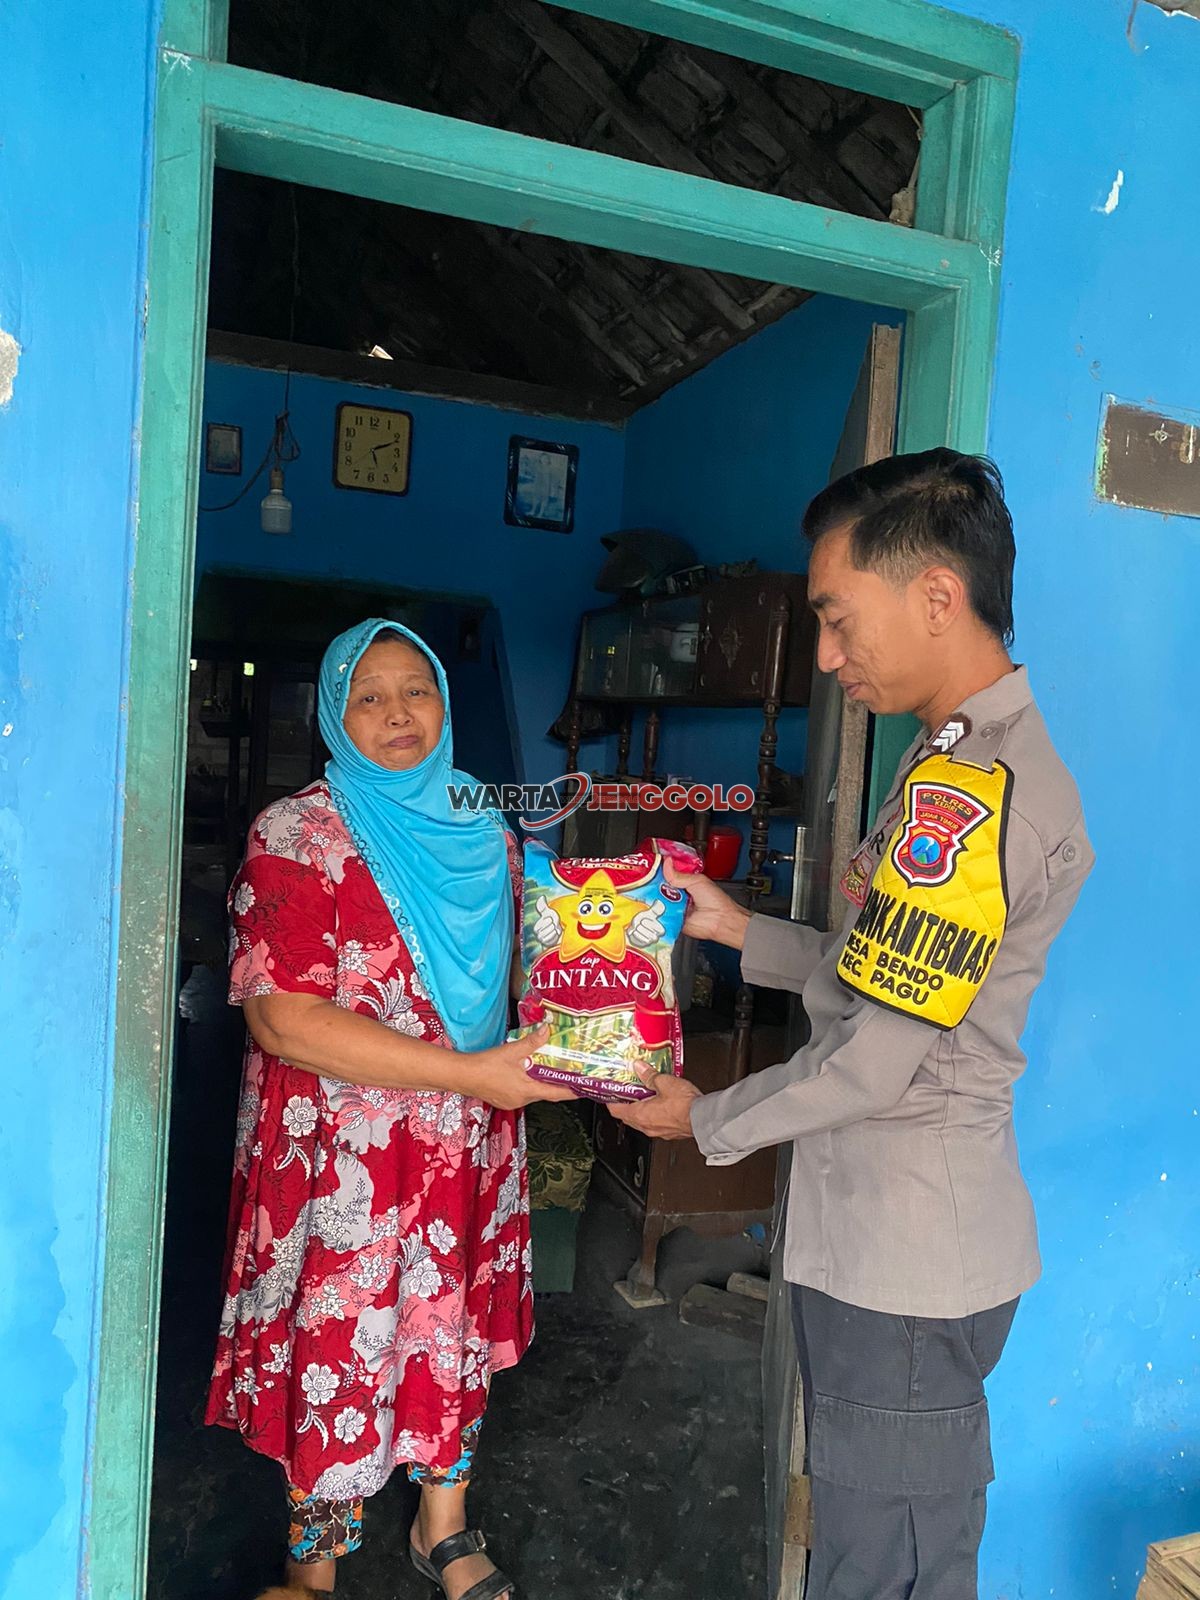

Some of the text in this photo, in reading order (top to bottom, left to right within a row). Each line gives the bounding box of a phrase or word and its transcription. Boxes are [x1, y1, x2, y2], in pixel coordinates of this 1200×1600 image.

[355, 415, 363, 426] 11
[369, 416, 380, 427] 12
[387, 420, 391, 430] 1
[346, 427, 356, 438] 10
[394, 432, 400, 443] 2
[345, 441, 352, 451] 9
[393, 448, 400, 458] 3
[345, 455, 352, 465] 8
[392, 462, 398, 472] 4
[353, 469, 360, 479] 7
[367, 472, 375, 482] 6
[383, 474, 389, 483] 5
[923, 793, 973, 815] POLRES
[934, 801, 958, 813] KEDIRI
[920, 811, 959, 831] JAWA TIMUR
[580, 956, 601, 968] cap
[876, 951, 944, 991] BENDO
[535, 968, 652, 991] LINTANG
[841, 950, 929, 1005] KEC PAGU
[539, 1068, 593, 1086] DIPRODUKSI
[601, 1082, 635, 1094] KEDIRI
